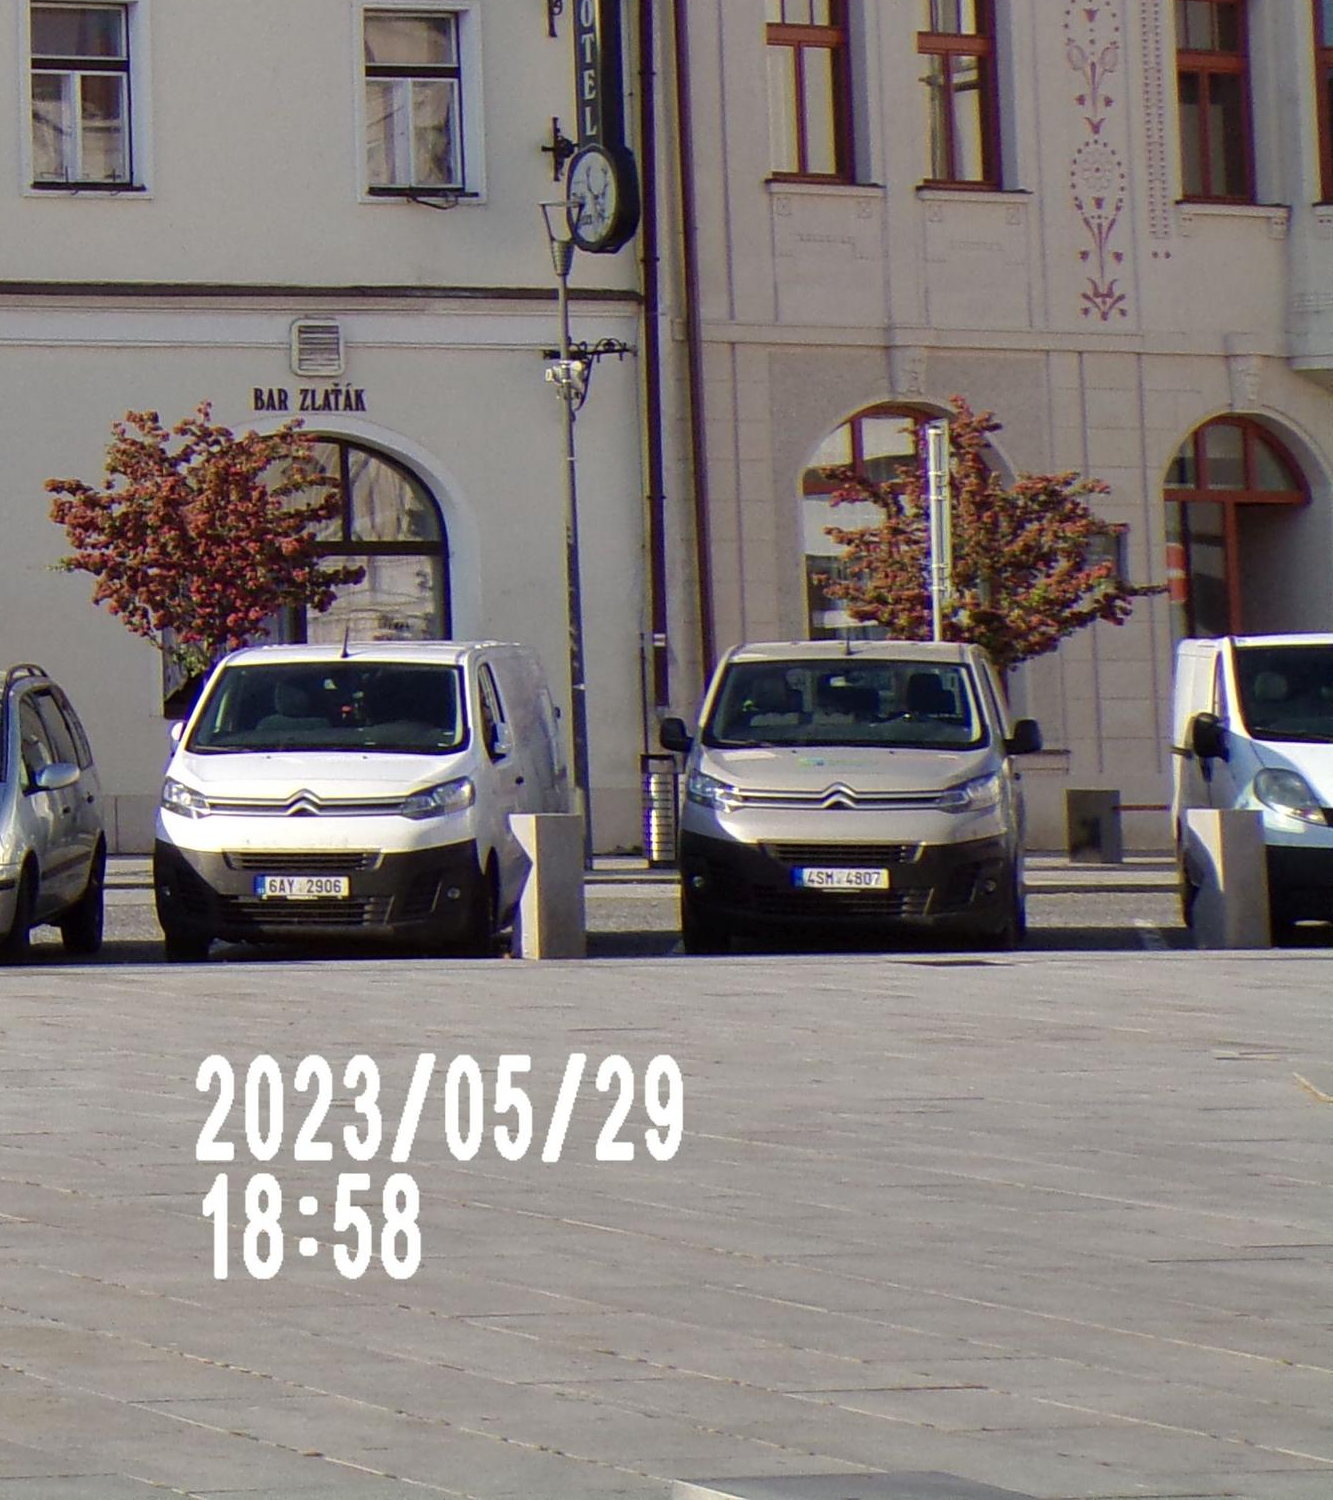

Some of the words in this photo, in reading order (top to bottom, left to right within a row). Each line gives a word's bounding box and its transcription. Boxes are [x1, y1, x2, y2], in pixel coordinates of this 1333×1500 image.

[253, 387, 288, 411] BAR
[299, 382, 366, 412] ZLAŤÁK
[269, 879, 294, 893] 6AY
[306, 879, 342, 894] 2906
